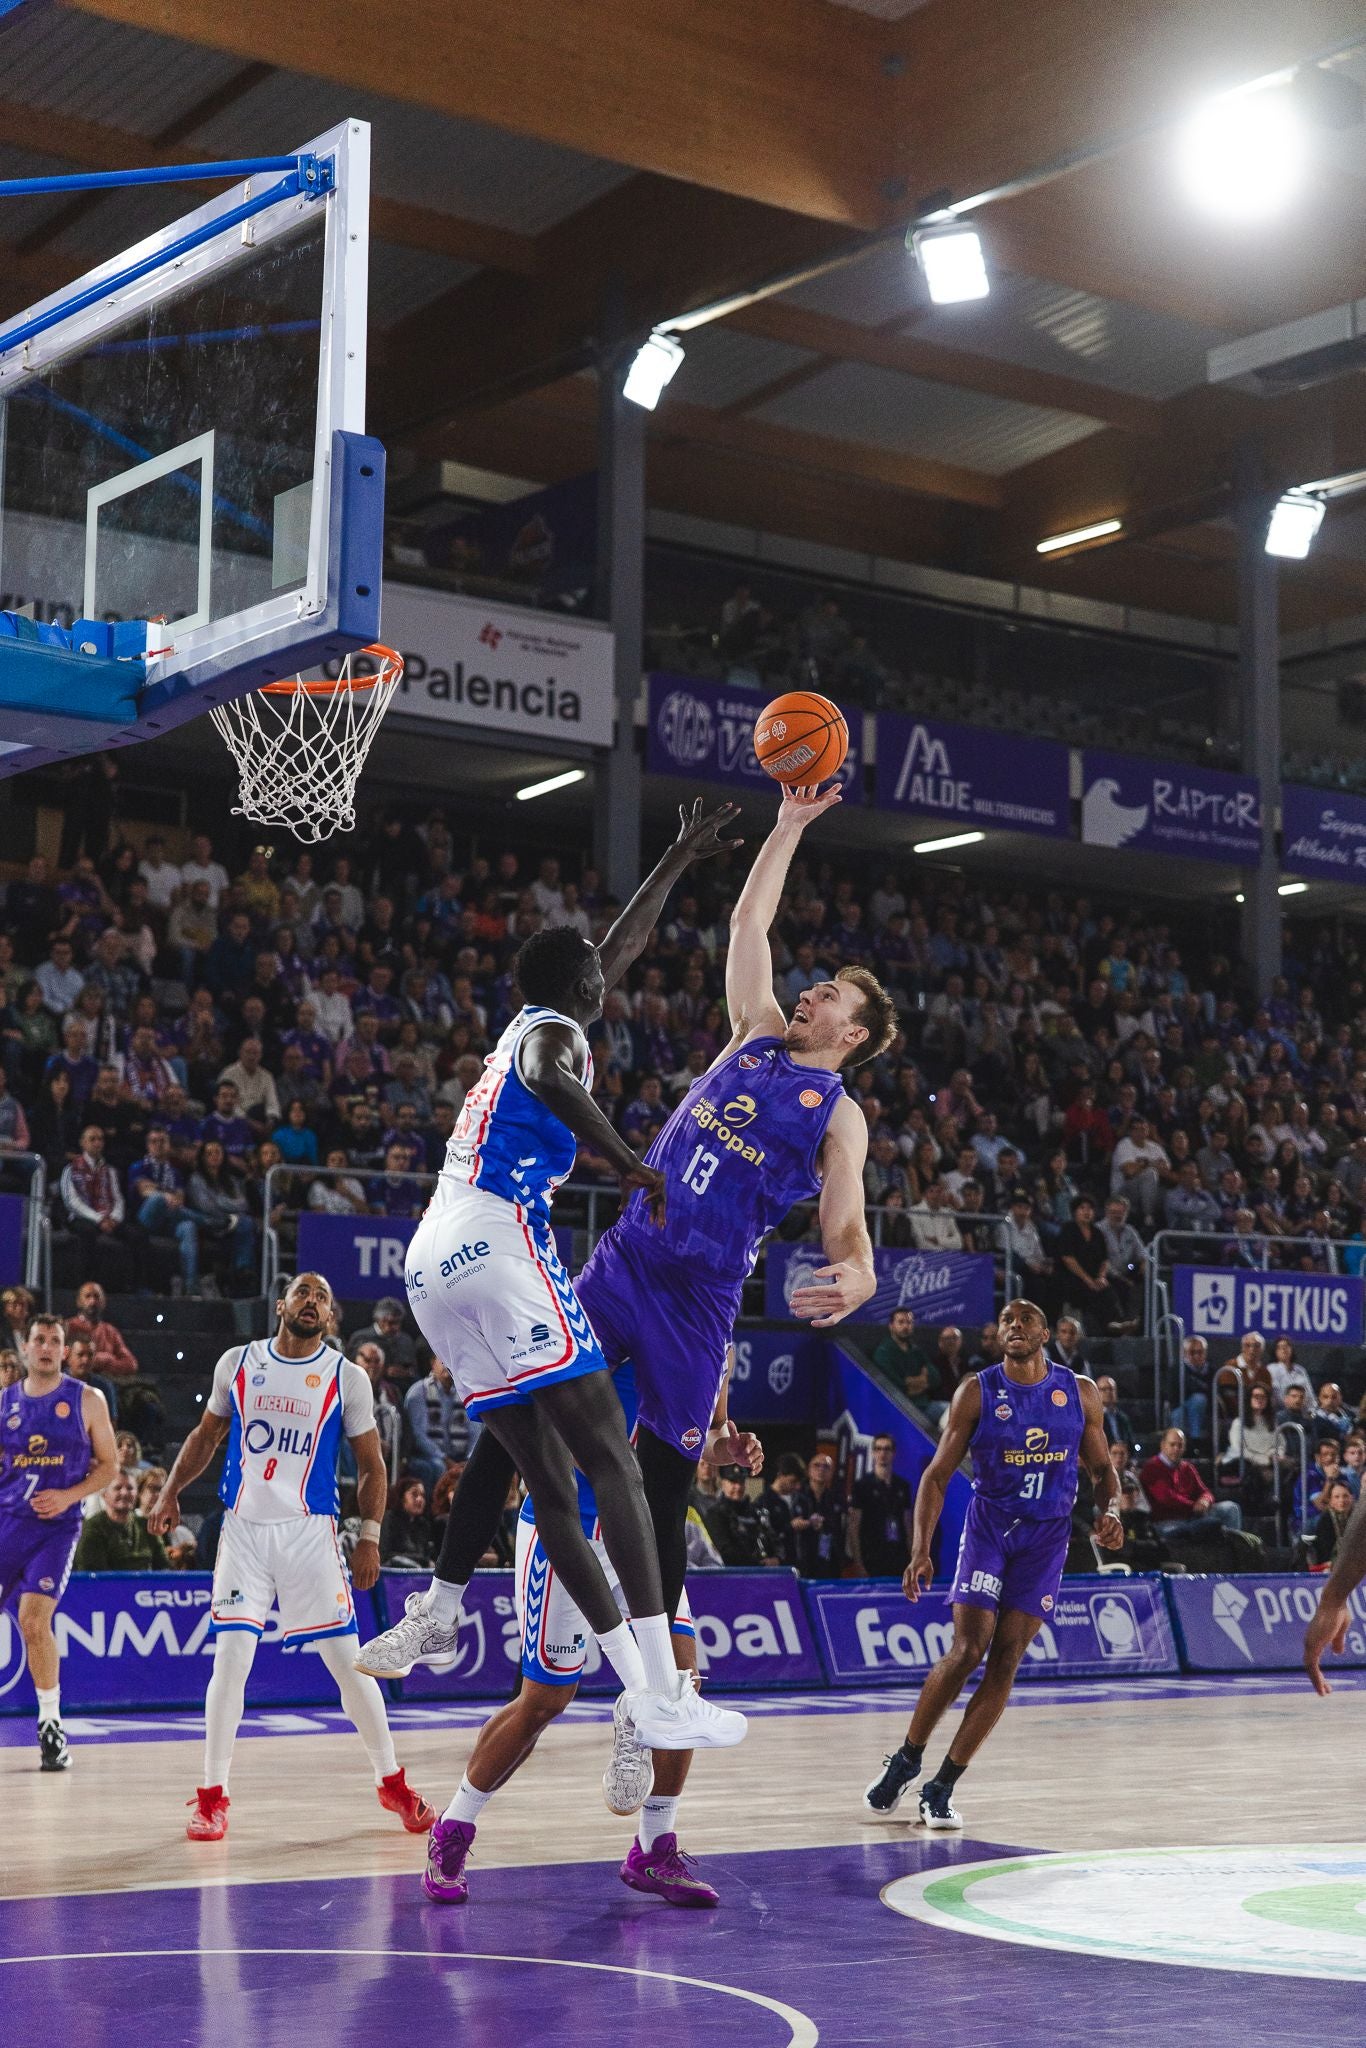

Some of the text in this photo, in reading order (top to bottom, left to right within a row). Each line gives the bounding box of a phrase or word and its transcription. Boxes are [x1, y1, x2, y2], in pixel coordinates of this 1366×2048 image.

[401, 652, 581, 723] Palencia
[909, 773, 971, 812] ALDE
[690, 1103, 766, 1167] agropal
[681, 1143, 720, 1196] 13
[439, 1240, 491, 1278] ante
[445, 1262, 486, 1290] estination
[1243, 1282, 1348, 1334] PETKUS
[528, 1340, 558, 1354] SEAT
[277, 1427, 313, 1458] HLA
[263, 1457, 278, 1481] 8
[1003, 1448, 1069, 1467] agropal
[23, 1473, 40, 1501] 7
[1018, 1471, 1045, 1500] 31
[134, 1590, 214, 1608] GRUP
[545, 1643, 577, 1654] suma
